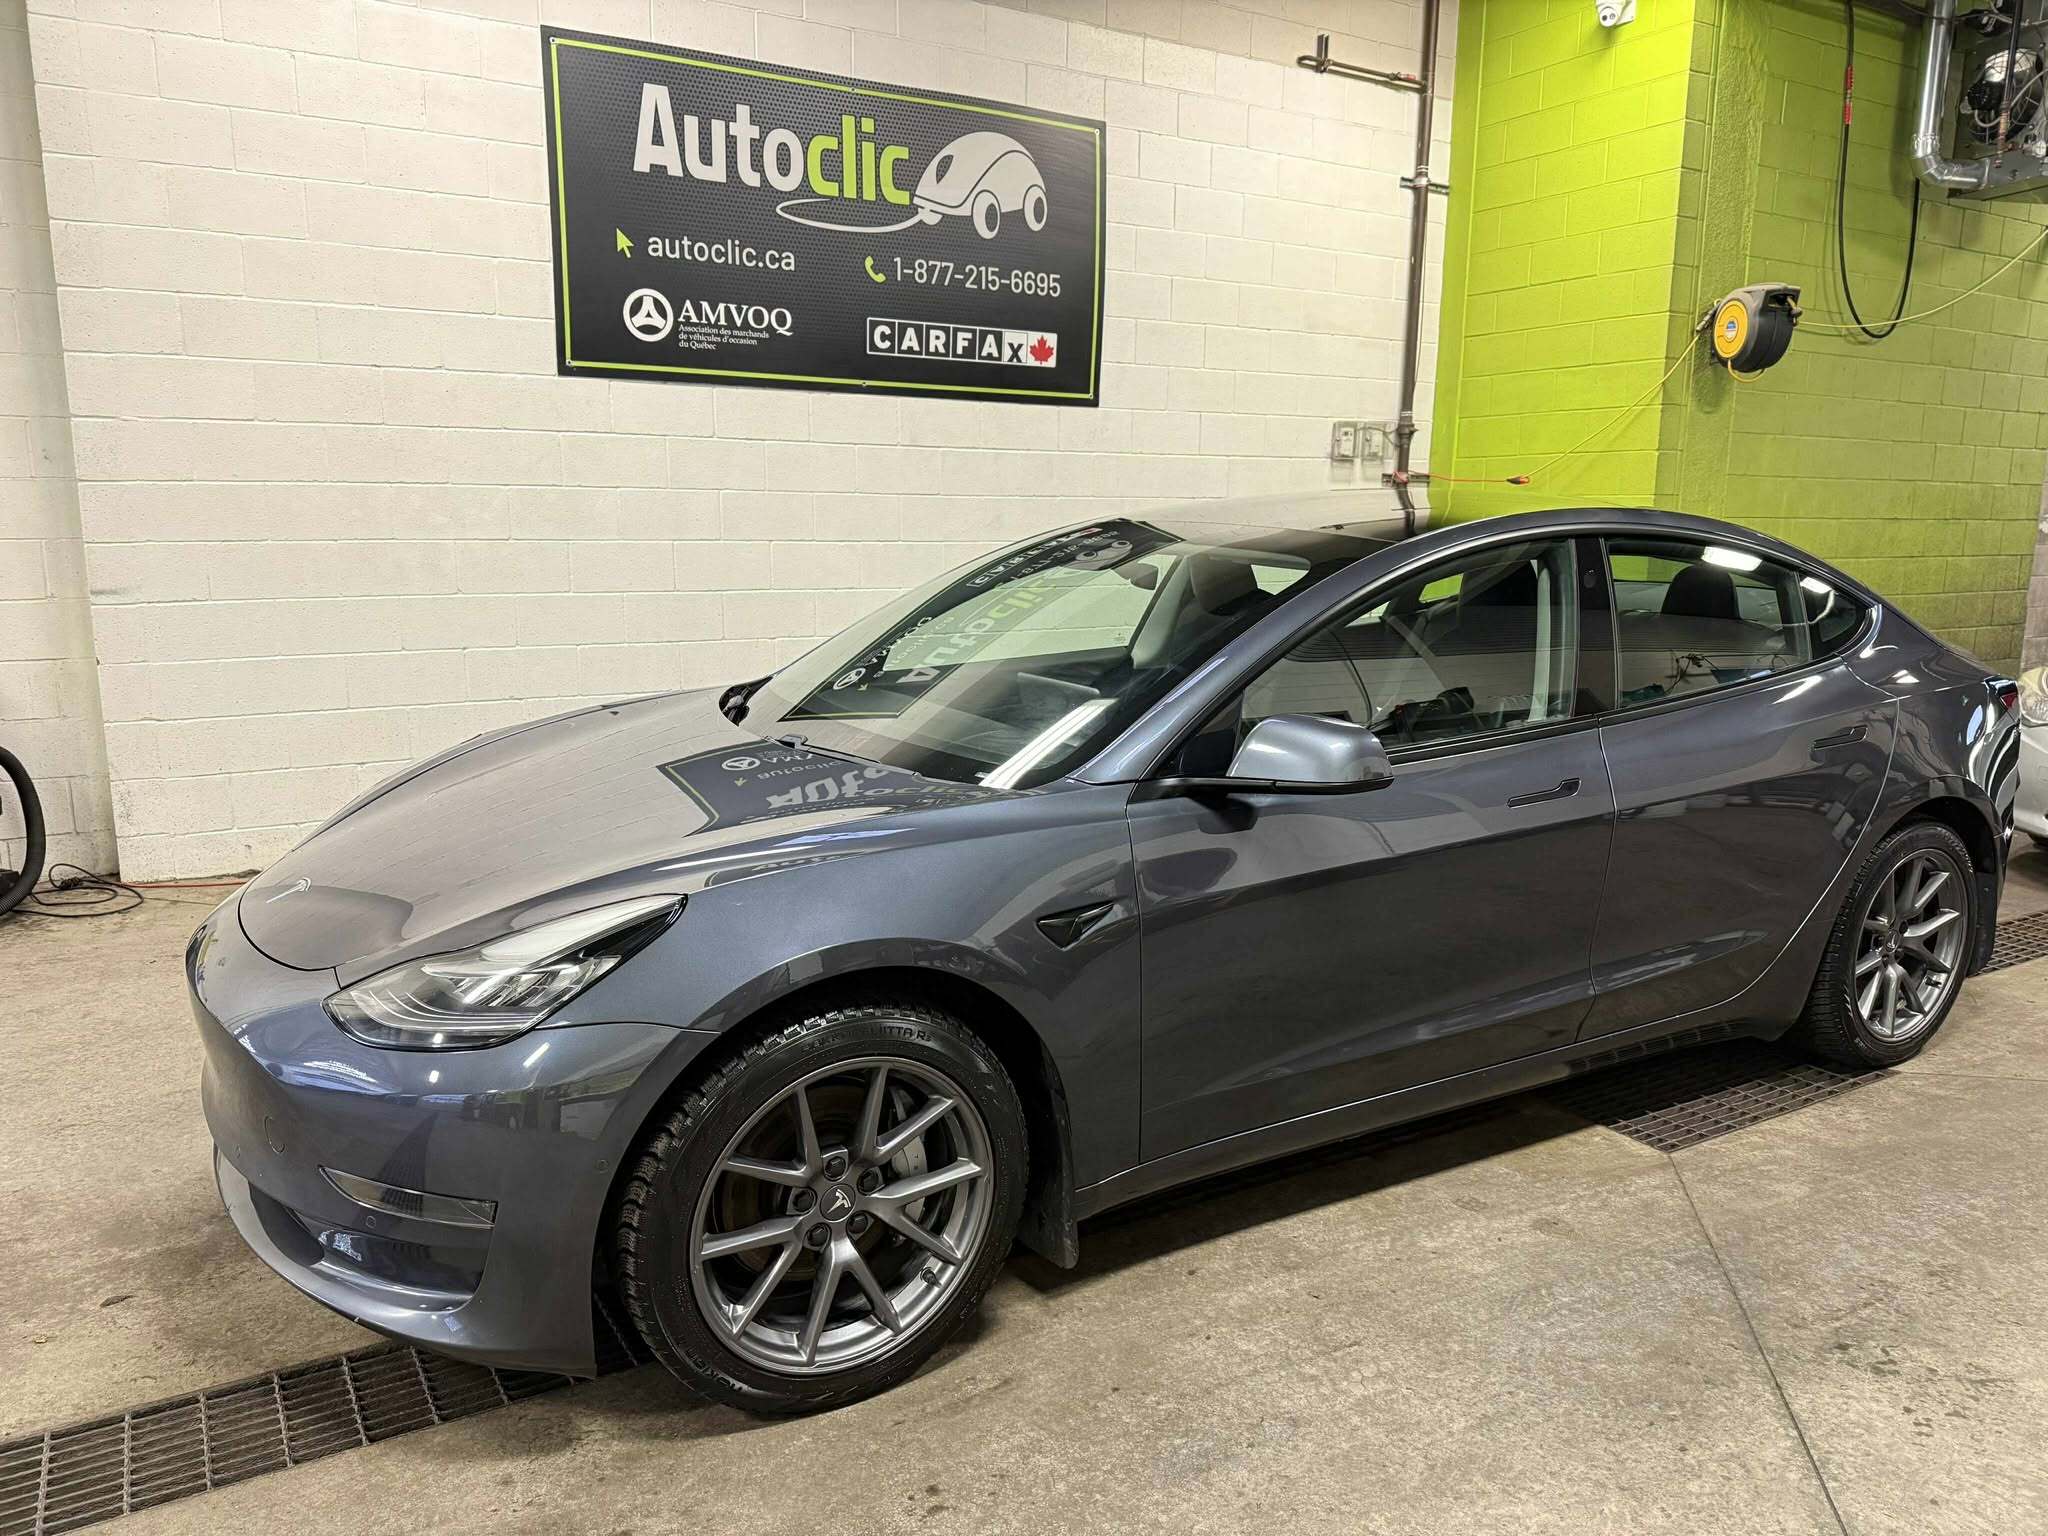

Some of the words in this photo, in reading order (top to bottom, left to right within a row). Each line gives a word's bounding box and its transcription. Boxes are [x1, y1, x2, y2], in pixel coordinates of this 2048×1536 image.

[633, 82, 911, 206] Autoclic
[648, 236, 796, 271] autoclic.ca
[893, 257, 1061, 297] 1-877-215-6695
[678, 299, 794, 336] AMVOQ
[678, 324, 718, 336] Association
[719, 328, 732, 336] des
[733, 329, 770, 339] marchands
[678, 332, 688, 340] de
[689, 333, 722, 343] véhicules
[689, 340, 717, 350] Québec
[873, 324, 1025, 364] CARFAX
